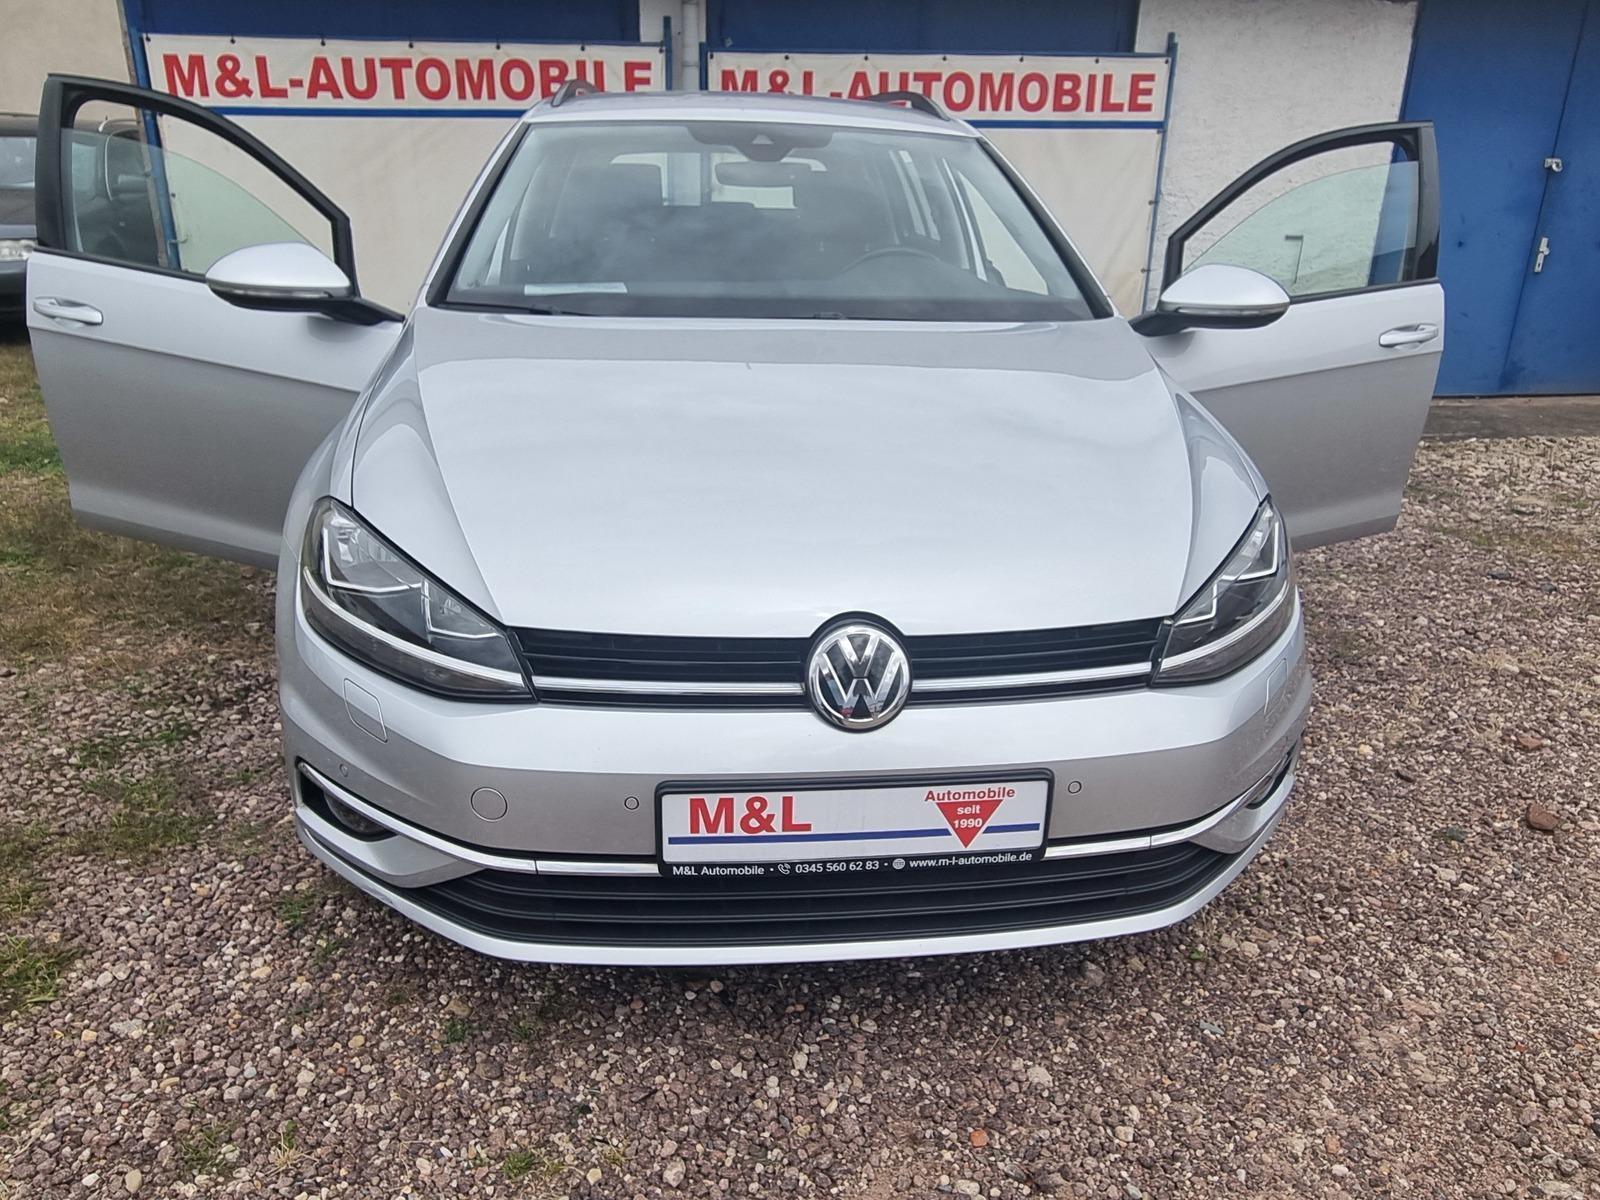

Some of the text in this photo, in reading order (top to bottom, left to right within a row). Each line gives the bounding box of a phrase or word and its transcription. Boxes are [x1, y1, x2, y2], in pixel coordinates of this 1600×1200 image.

[163, 53, 652, 101] M&L-AUTOMOBILE
[925, 787, 1016, 802] Automobile
[689, 796, 812, 835] M&L
[957, 804, 981, 815] seit
[953, 818, 983, 829] 1990
[672, 865, 699, 876] M&L
[701, 865, 765, 876] Automobile
[795, 862, 824, 873] 0345
[826, 861, 847, 872] 560
[849, 860, 863, 871] 62
[865, 860, 880, 870] 83
